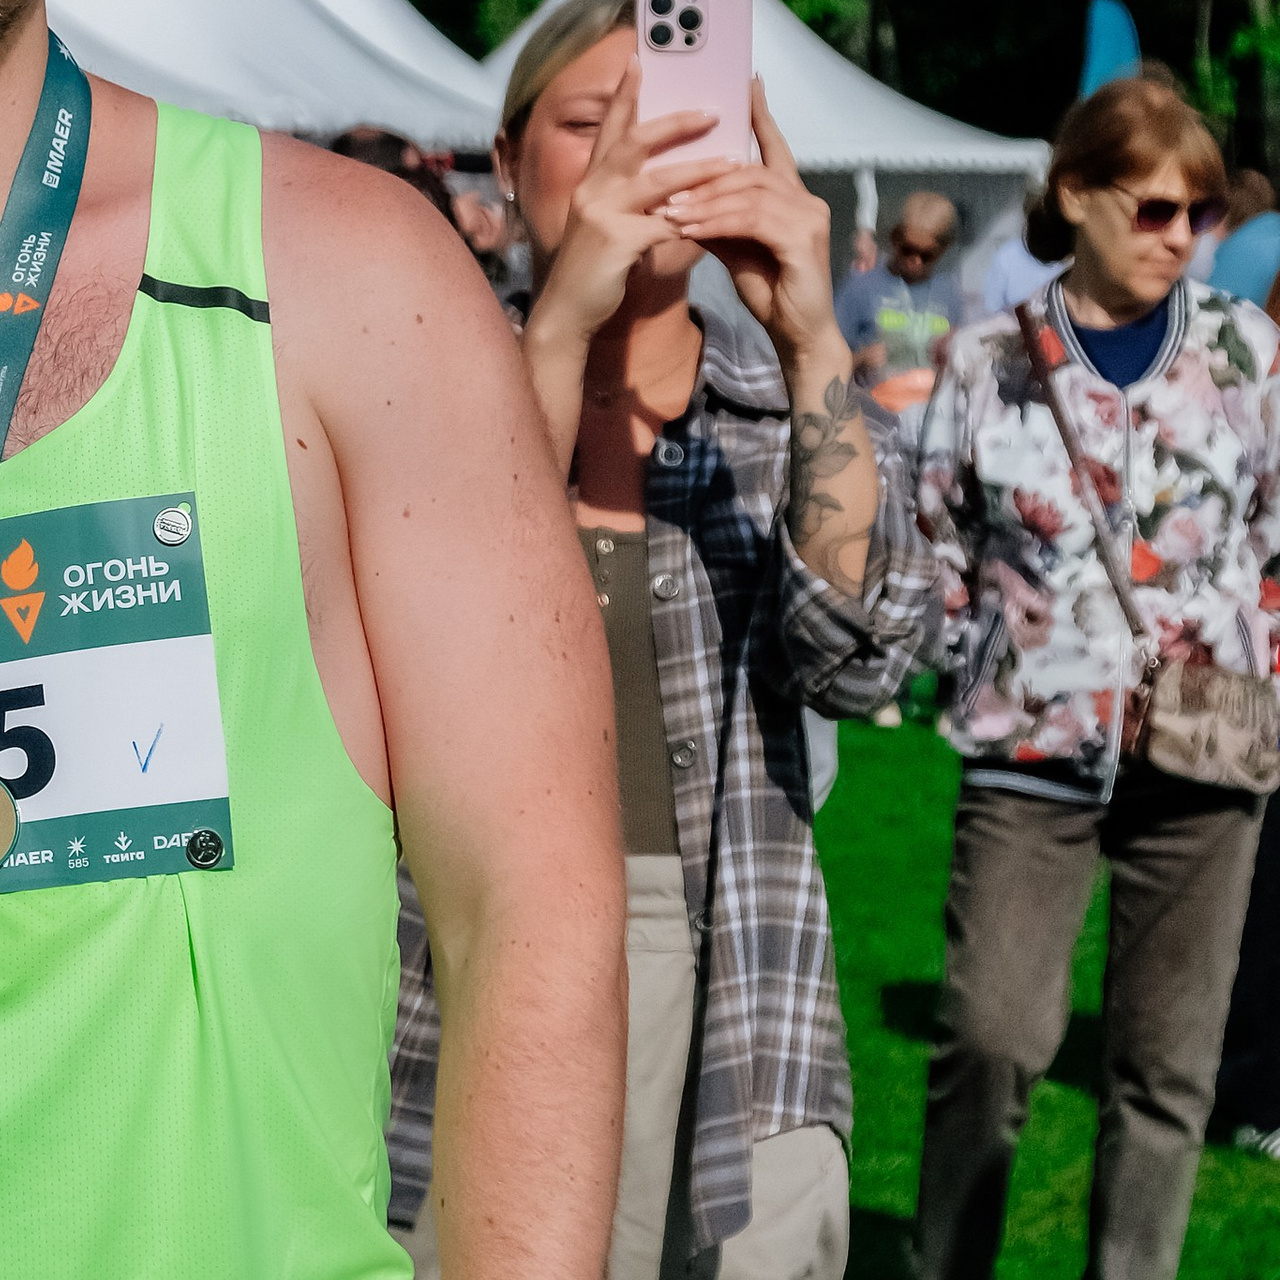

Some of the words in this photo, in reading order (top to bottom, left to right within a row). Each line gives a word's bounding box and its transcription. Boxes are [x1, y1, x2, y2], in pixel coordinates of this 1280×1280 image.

[45, 107, 73, 174] MAER
[11, 233, 37, 283] ОГОНЬ
[24, 231, 53, 288] ЖИЗНИ
[63, 555, 170, 588] ОГОНЬ
[58, 579, 182, 617] ЖИЗНИ
[68, 858, 90, 869] 585
